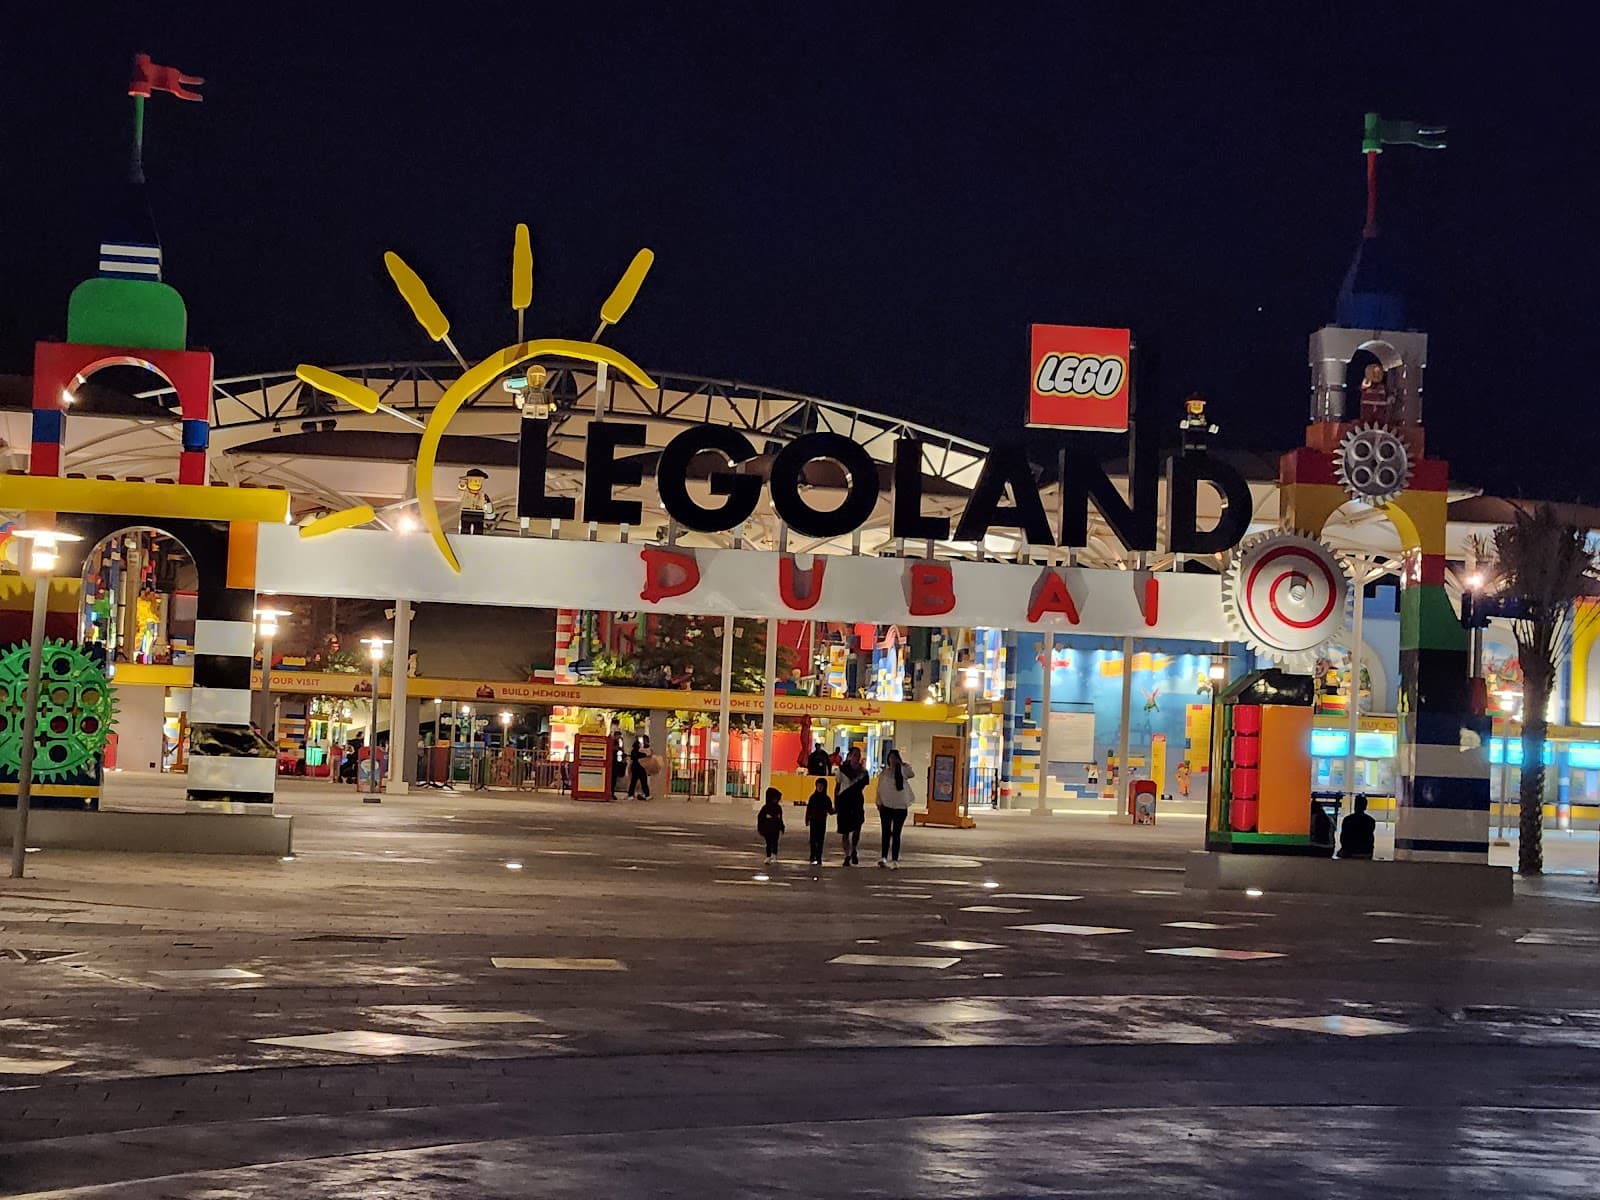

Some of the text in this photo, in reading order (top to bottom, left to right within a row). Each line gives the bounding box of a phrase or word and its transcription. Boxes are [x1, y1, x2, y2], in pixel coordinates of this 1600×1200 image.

[1037, 354, 1123, 396] LEGO
[517, 417, 1253, 555] LEGOLAND
[641, 549, 1160, 627] DUBAI
[270, 677, 294, 686] OUR
[296, 678, 320, 687] VISIT
[502, 687, 581, 699] BUILD MEMORIES
[704, 698, 751, 708] WEOME
[774, 701, 819, 711] EGOLAND
[824, 704, 853, 713] DUBAI
